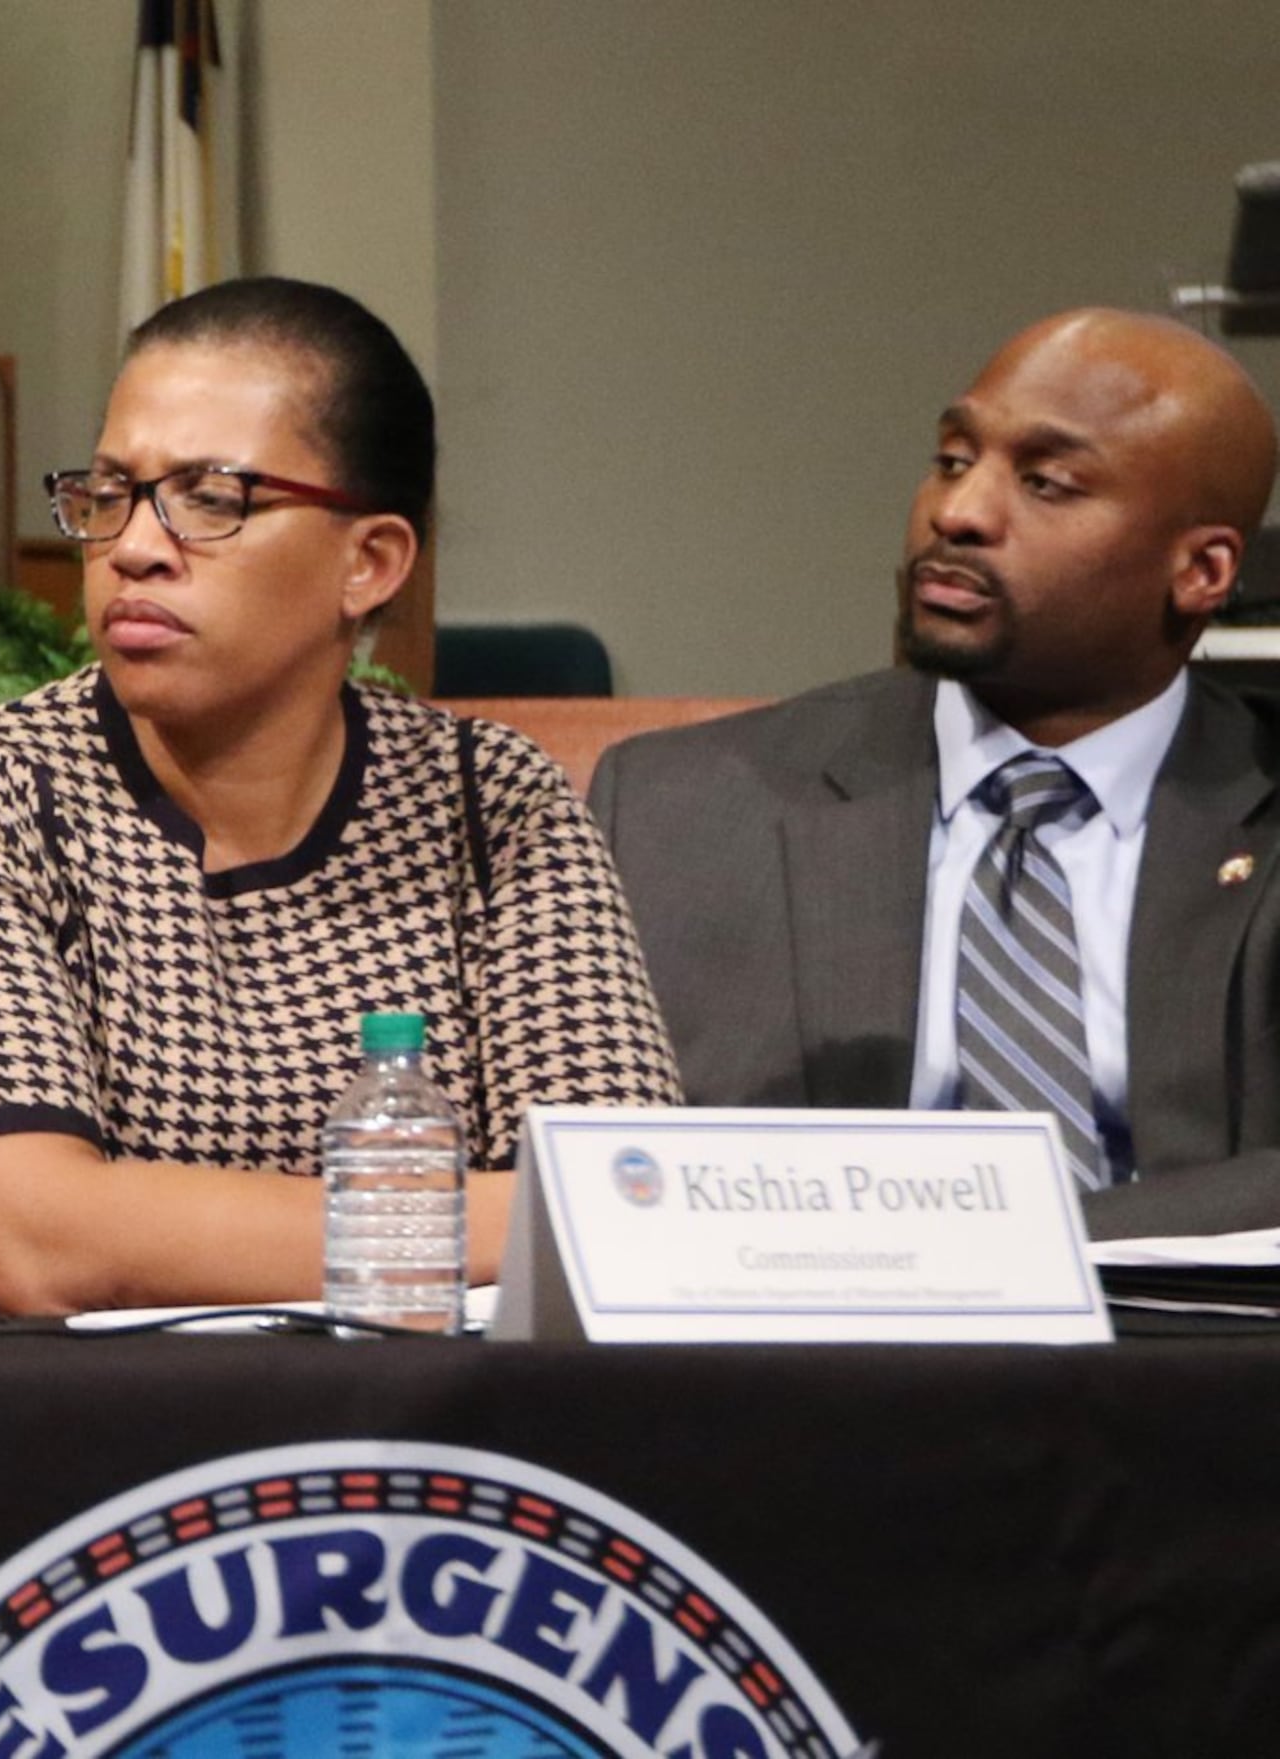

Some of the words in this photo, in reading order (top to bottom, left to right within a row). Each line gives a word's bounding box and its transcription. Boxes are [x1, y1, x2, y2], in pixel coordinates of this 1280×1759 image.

[680, 1163, 833, 1212] Kishia
[842, 1163, 1009, 1212] Powell
[738, 1246, 917, 1272] Commissioner
